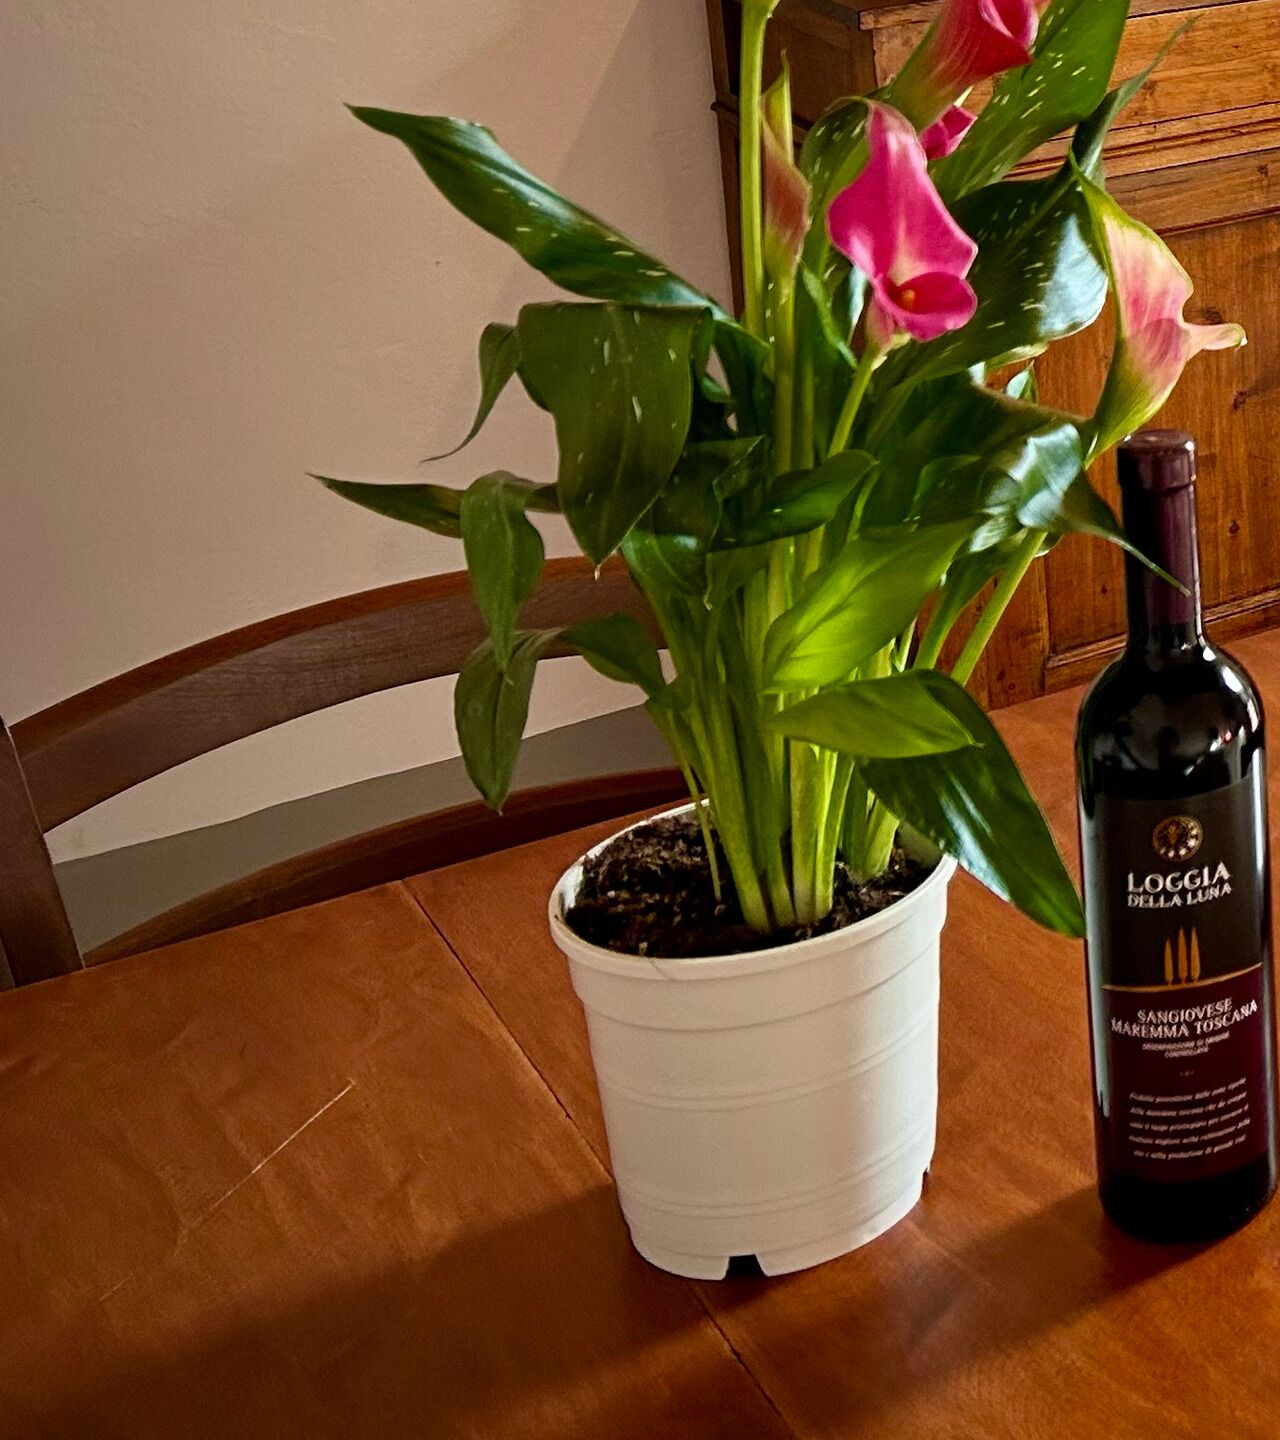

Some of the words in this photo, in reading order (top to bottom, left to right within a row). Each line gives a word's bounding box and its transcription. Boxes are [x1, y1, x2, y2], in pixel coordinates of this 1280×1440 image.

[1127, 861, 1231, 894] LOGGIA
[1127, 893, 1183, 908] DELLA
[1186, 882, 1232, 905] LUNA
[1111, 1017, 1190, 1038] MAREMMA
[1194, 1000, 1258, 1035] TOSCANA
[1137, 997, 1232, 1024] SANGIOVESE
